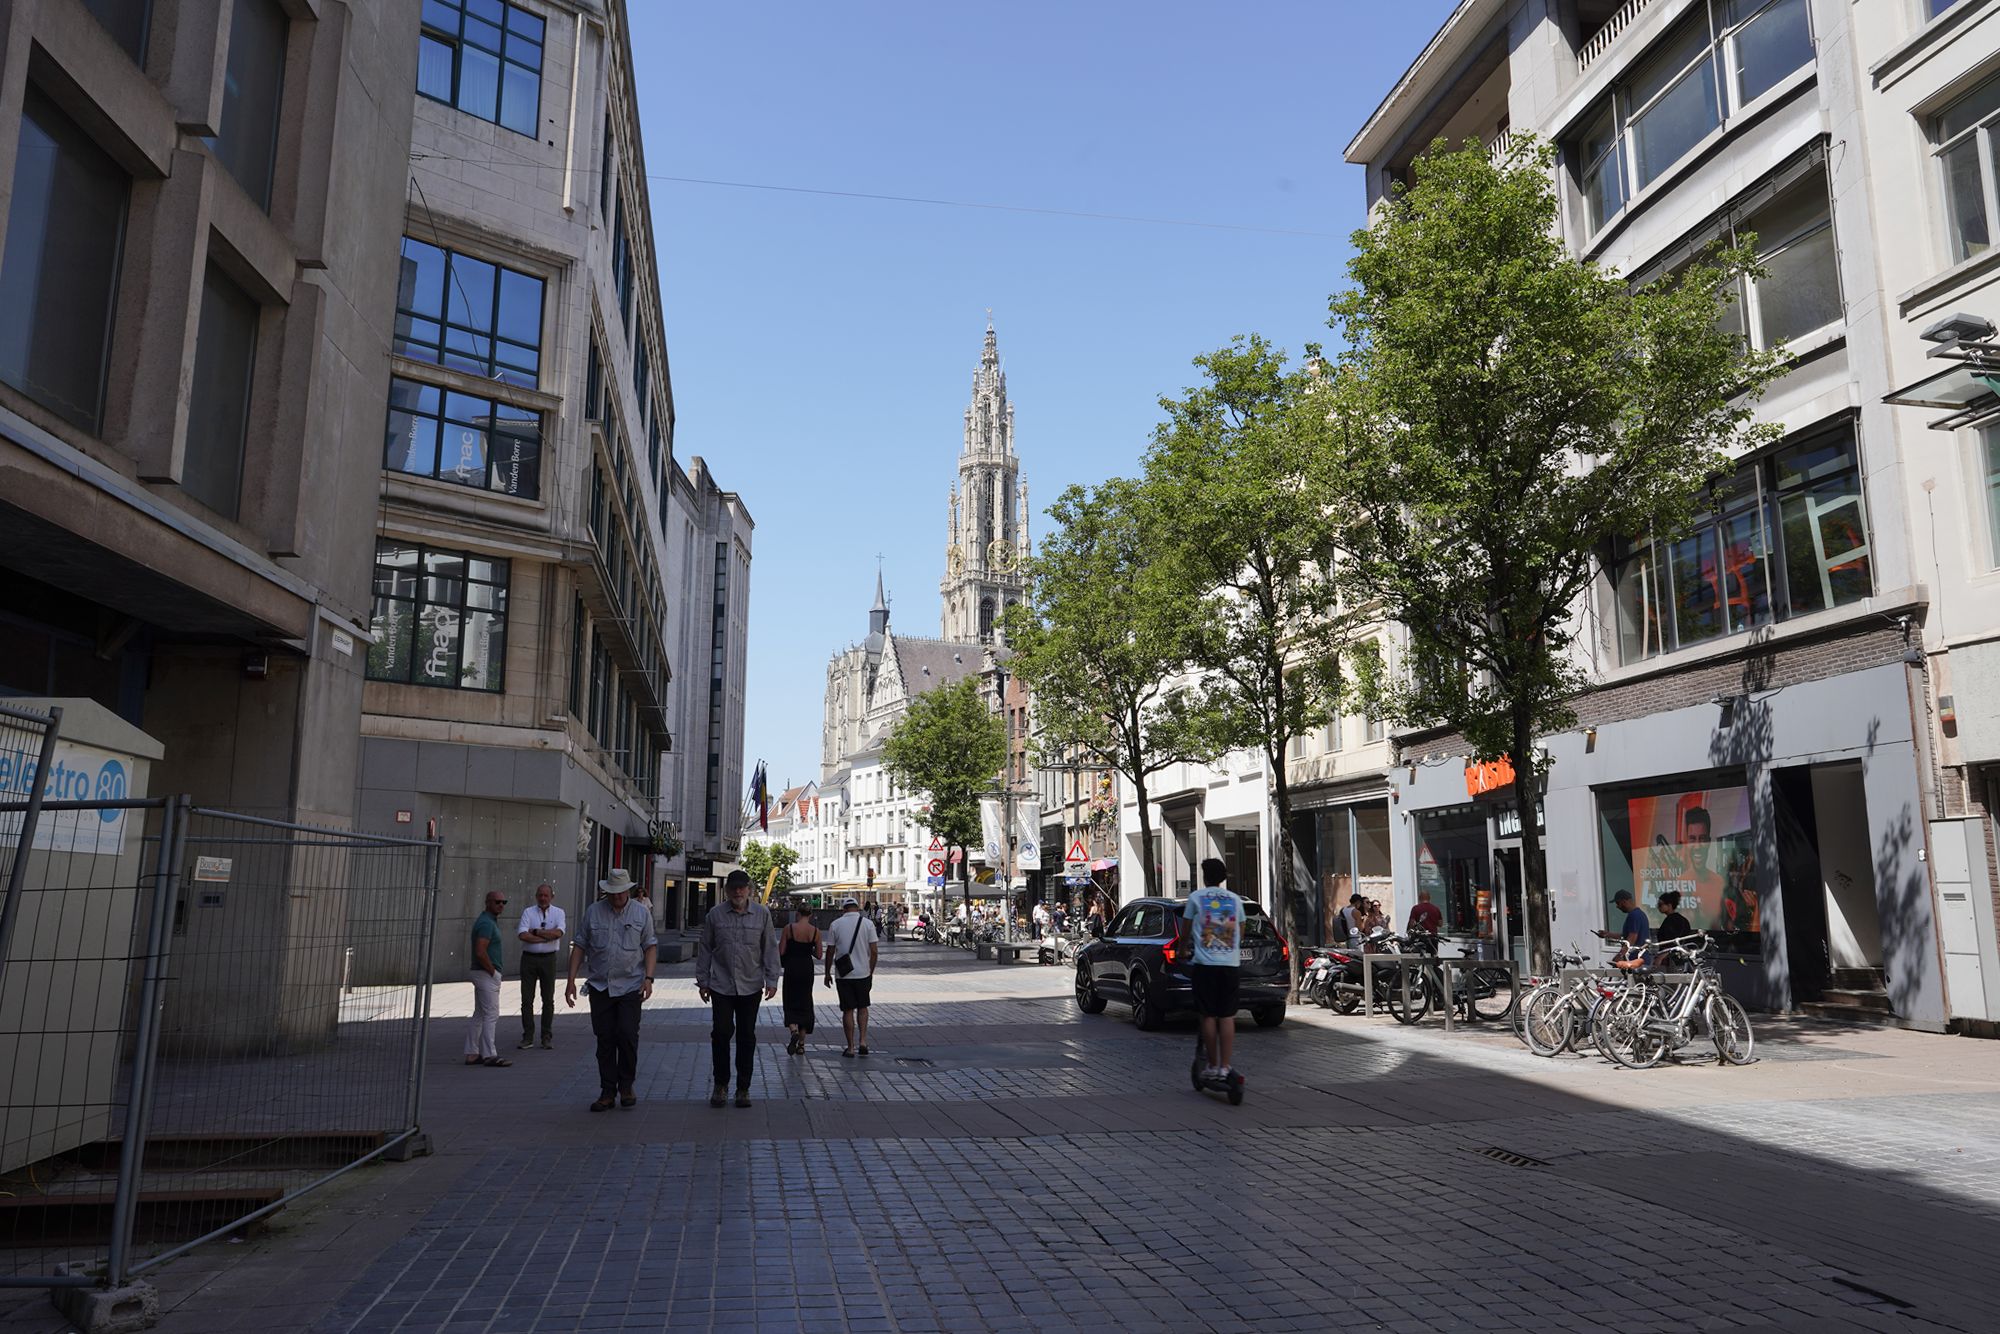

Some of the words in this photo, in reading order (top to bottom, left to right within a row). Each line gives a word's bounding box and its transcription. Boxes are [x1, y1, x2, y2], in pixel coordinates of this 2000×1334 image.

[456, 432, 474, 478] fnac
[511, 438, 521, 463] Borre
[509, 463, 520, 494] Vanden
[385, 634, 397, 670] Vanden
[425, 612, 451, 678] fnac
[97, 770, 125, 811] 80
[690, 864, 710, 872] Hilton
[1640, 868, 1665, 879] SPORT
[1669, 867, 1682, 878] NU
[1655, 880, 1697, 893] WEKEN
